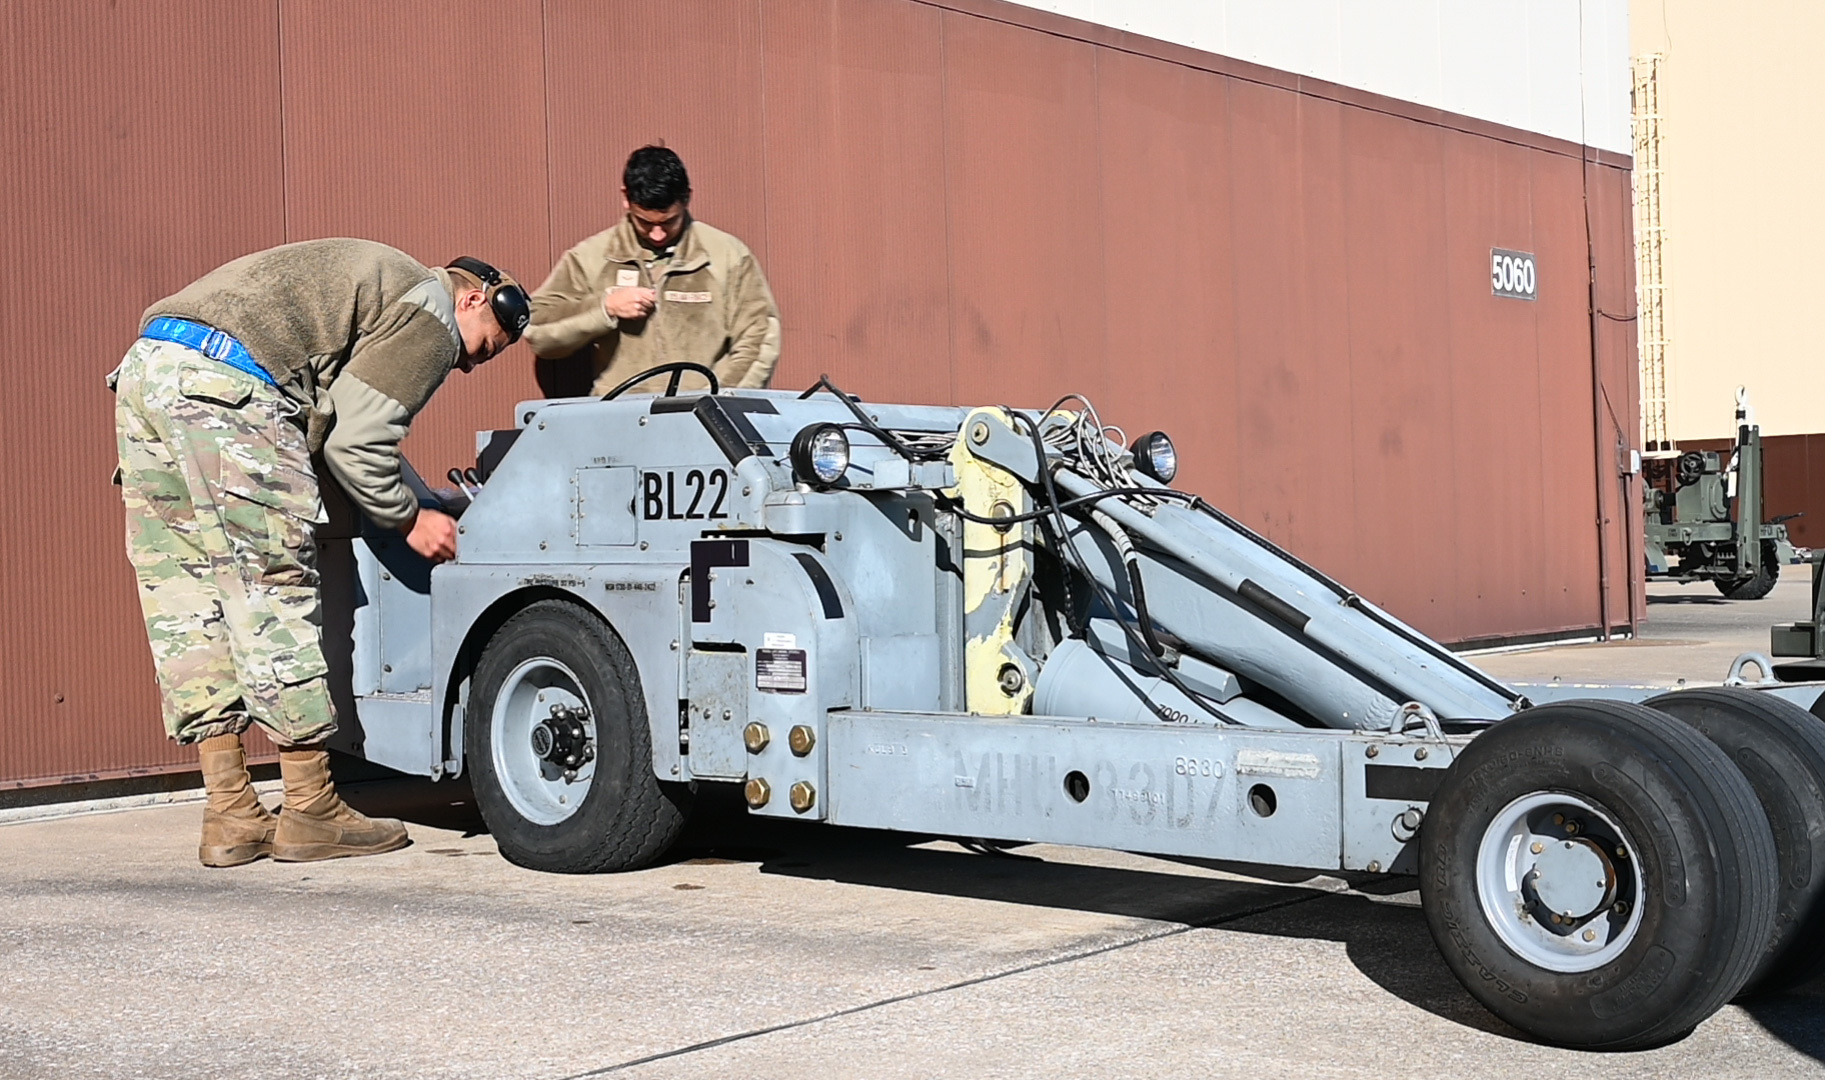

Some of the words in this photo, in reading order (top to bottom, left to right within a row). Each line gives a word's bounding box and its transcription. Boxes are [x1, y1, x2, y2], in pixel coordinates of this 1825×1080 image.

[1492, 254, 1535, 294] 5060
[643, 468, 728, 520] BL22
[1175, 756, 1225, 780] 8630
